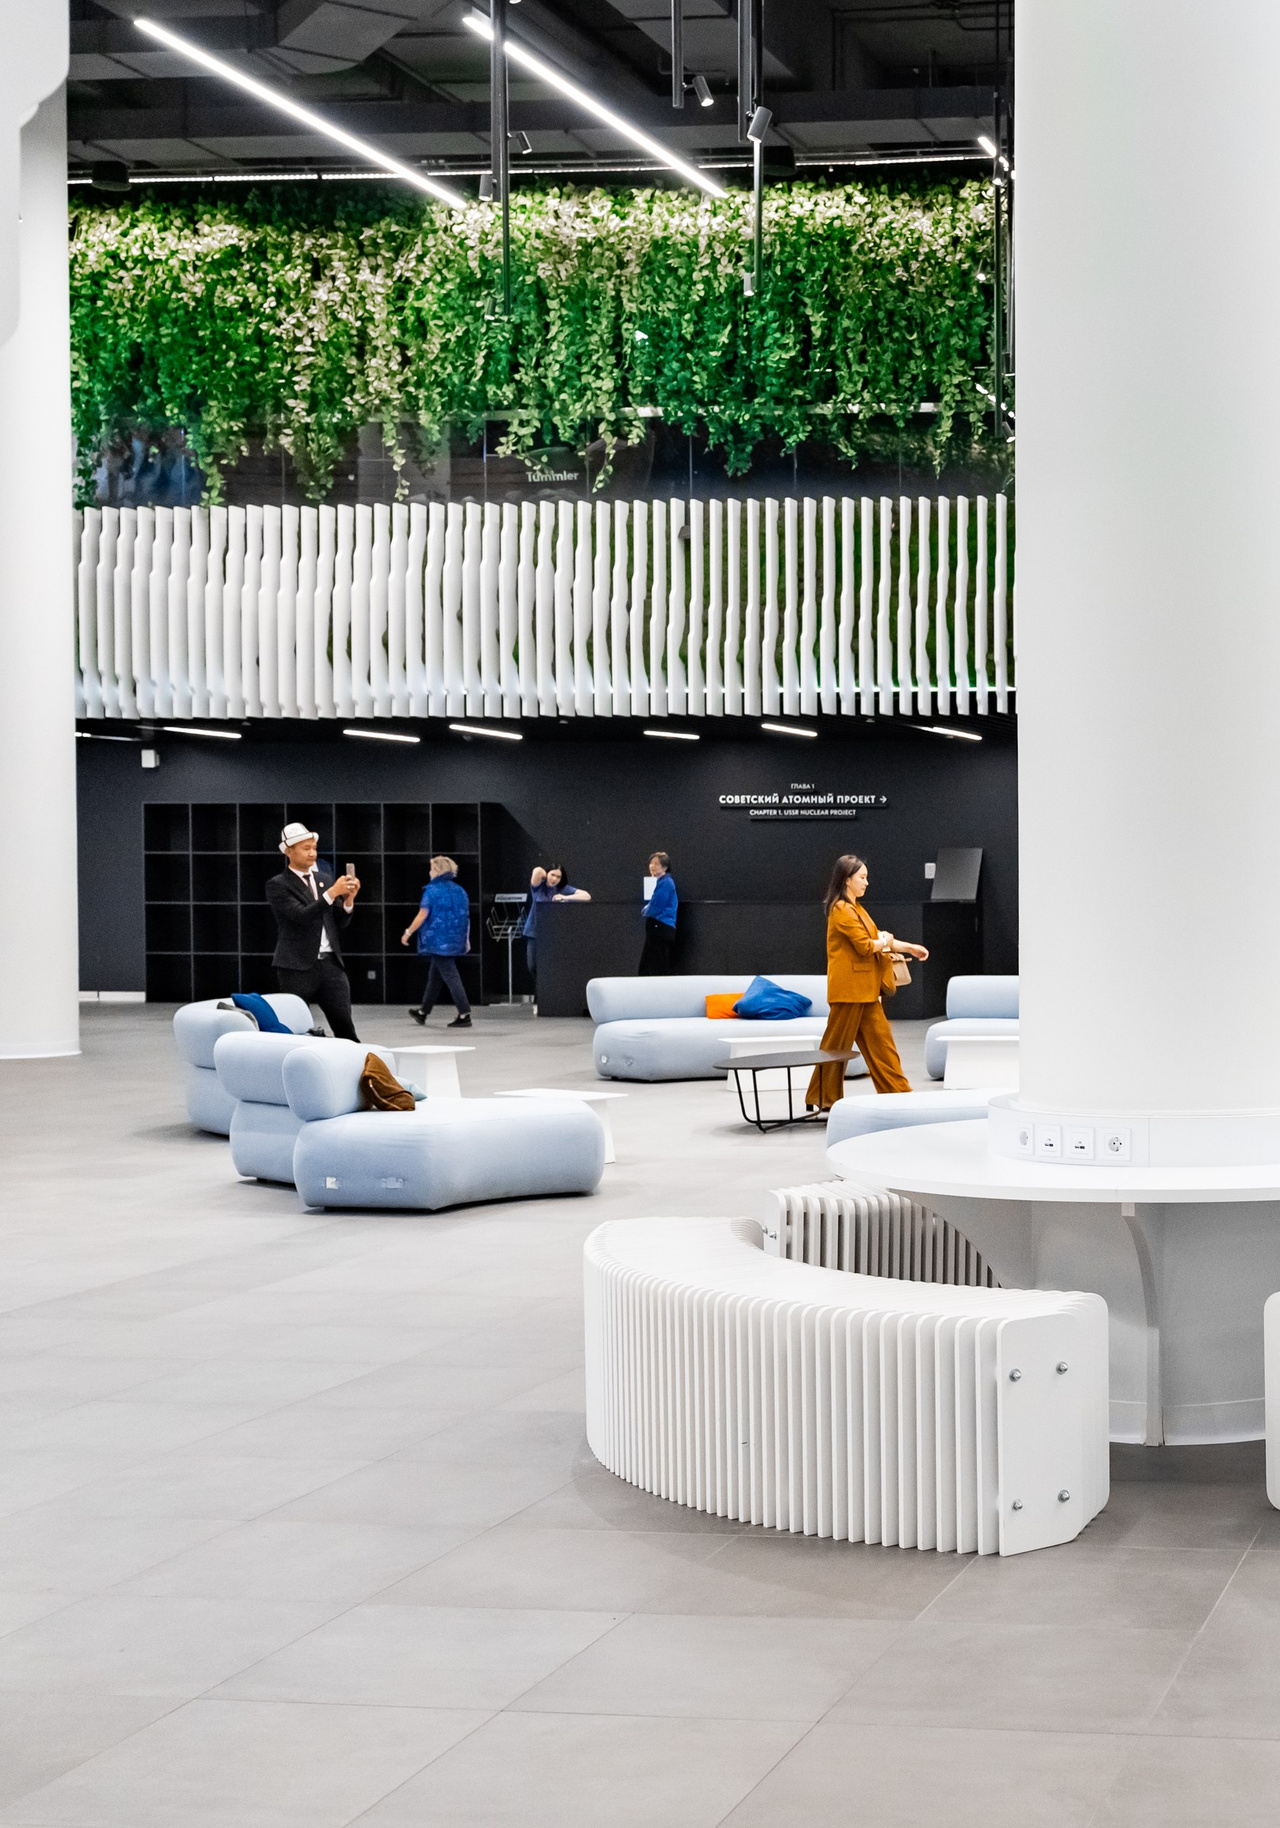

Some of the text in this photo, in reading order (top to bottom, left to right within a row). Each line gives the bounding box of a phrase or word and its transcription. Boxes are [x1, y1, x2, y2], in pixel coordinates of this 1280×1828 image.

[718, 792, 876, 804] СОВЕТСКИЙ АТОМНЫЙ ПРОЕКТ
